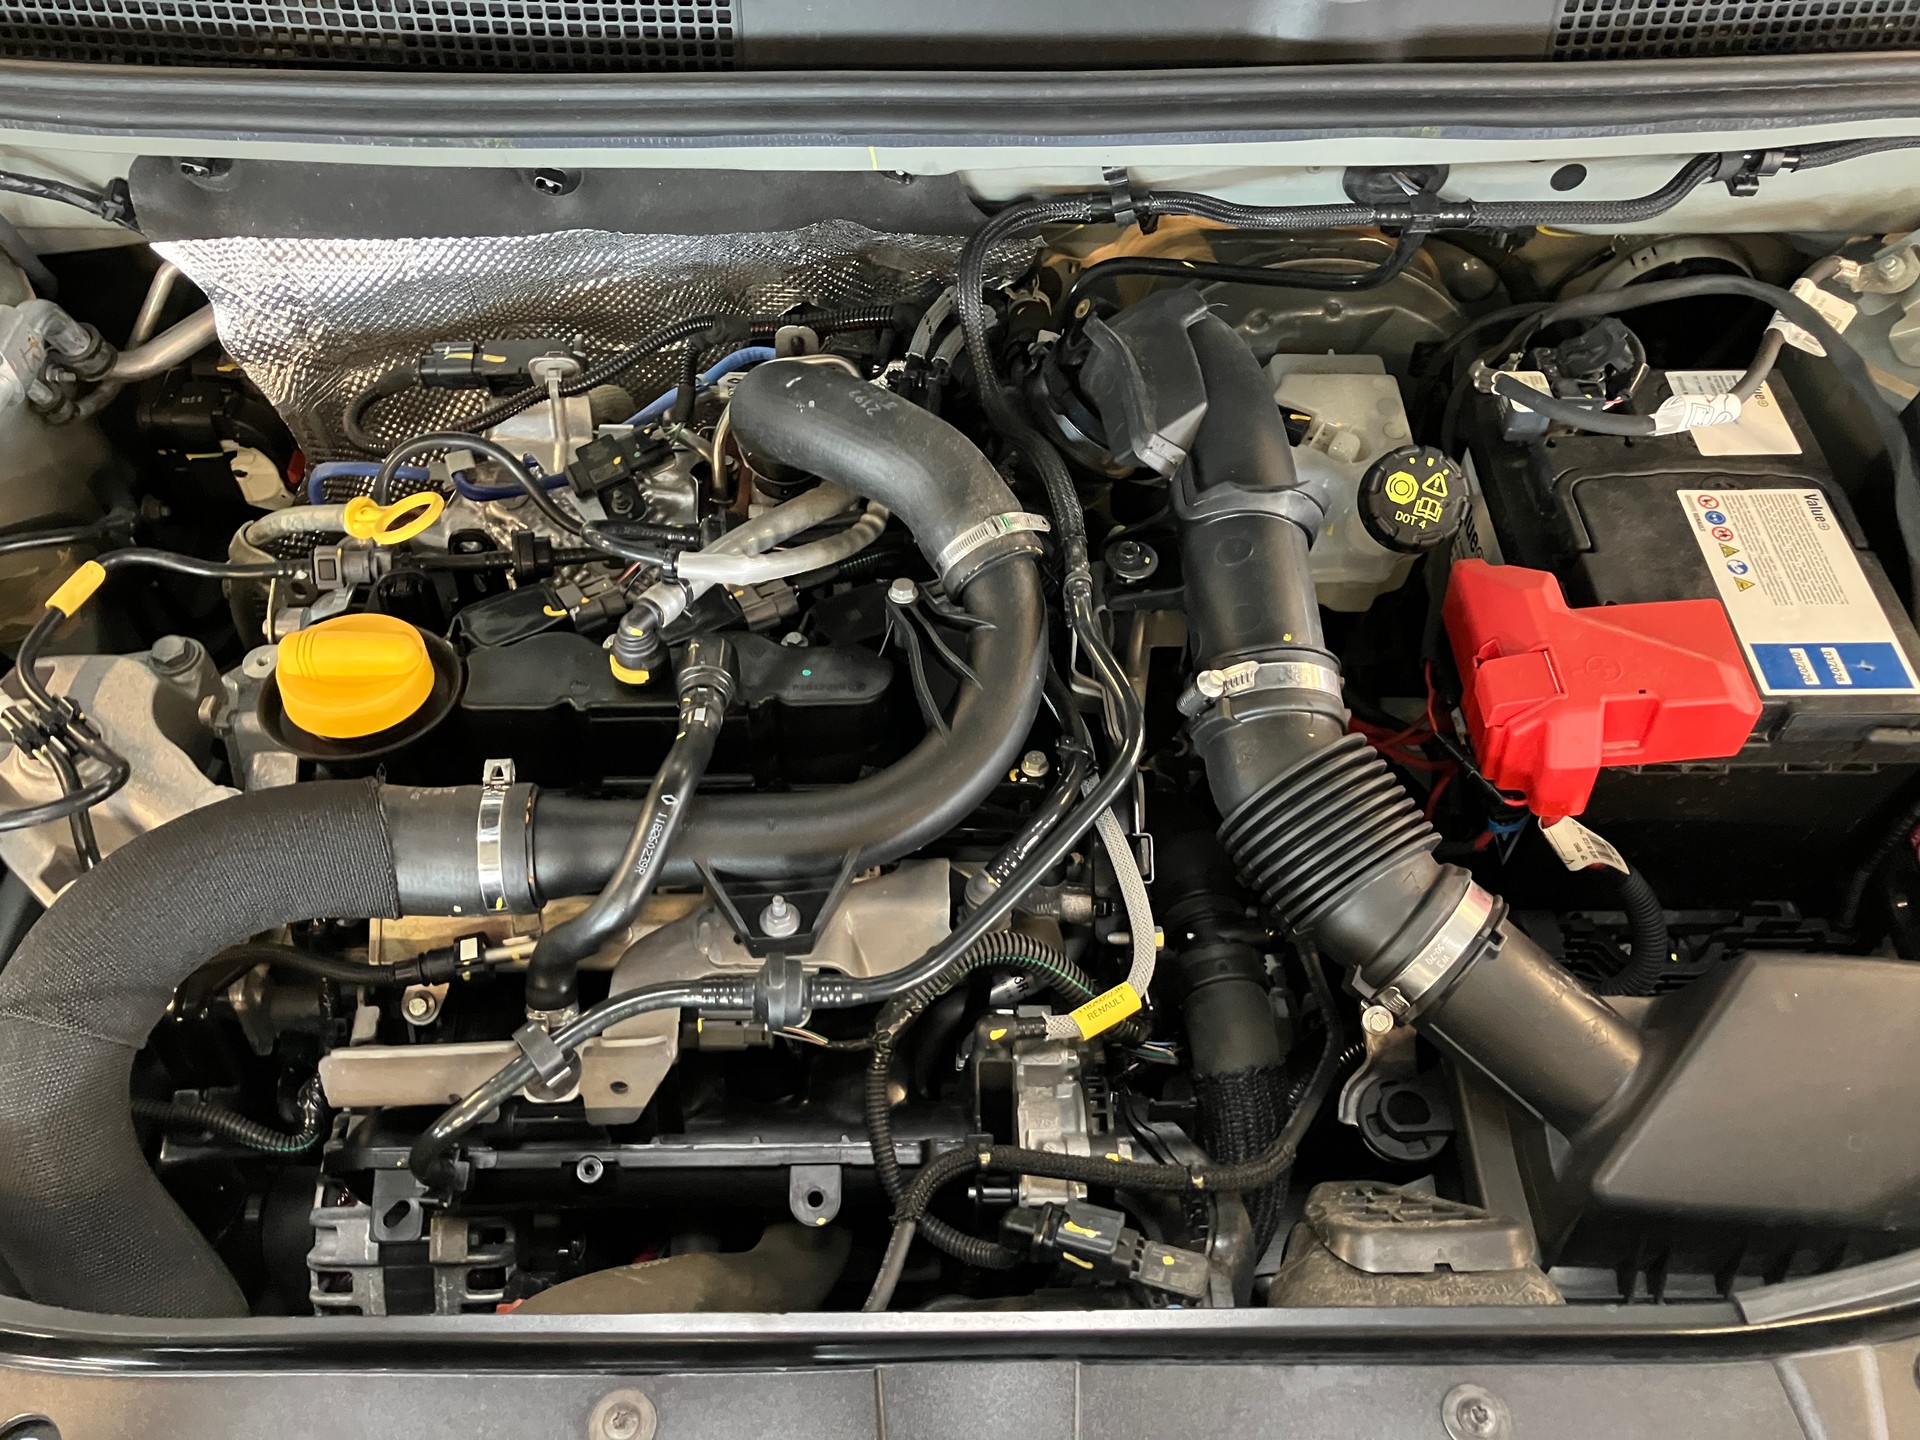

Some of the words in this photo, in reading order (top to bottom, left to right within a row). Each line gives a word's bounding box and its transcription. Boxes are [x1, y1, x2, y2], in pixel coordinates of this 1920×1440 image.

[1395, 511, 1418, 525] DOT
[1419, 520, 1427, 529] 4
[1804, 494, 1826, 522] Value
[1792, 652, 1813, 682] 09/2026
[1824, 651, 1845, 682] 03/2026
[635, 812, 667, 875] 118260239R
[1087, 994, 1125, 1021] RENAULT
